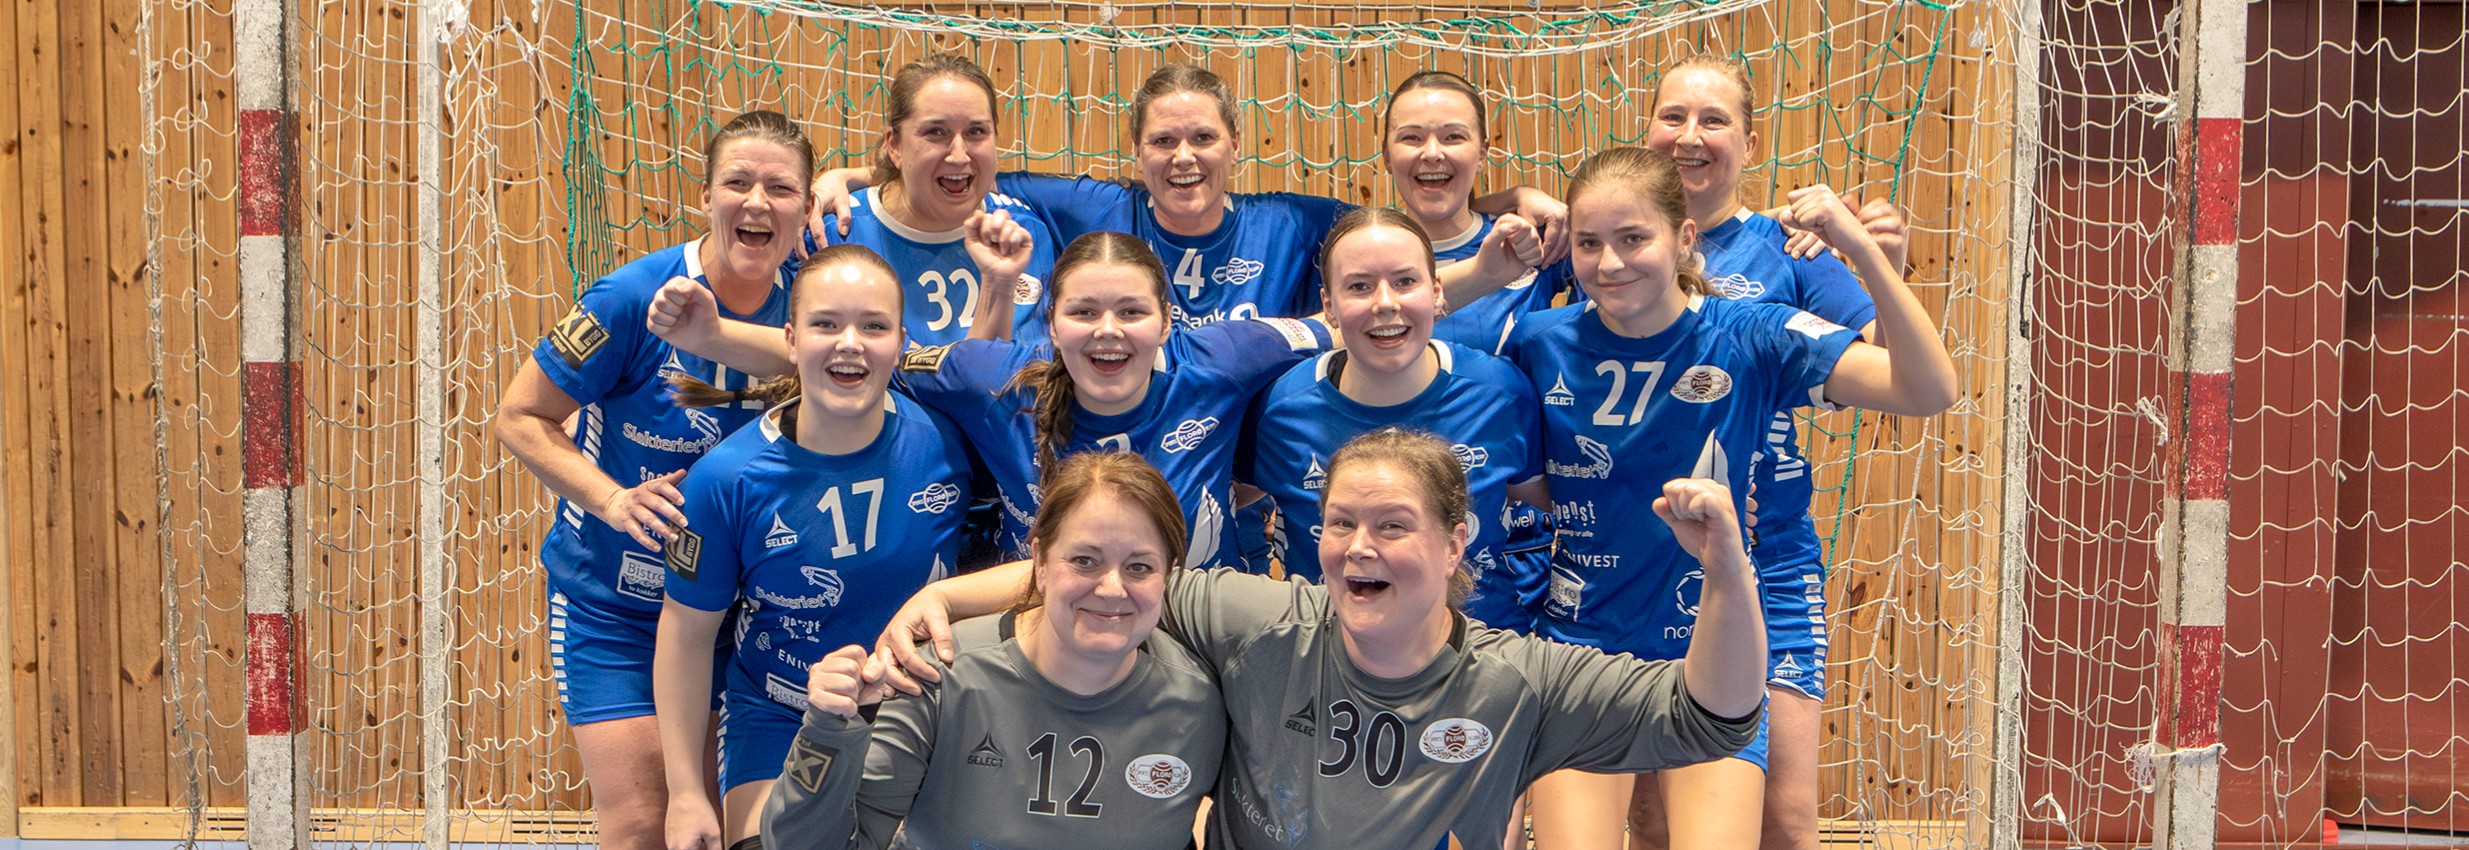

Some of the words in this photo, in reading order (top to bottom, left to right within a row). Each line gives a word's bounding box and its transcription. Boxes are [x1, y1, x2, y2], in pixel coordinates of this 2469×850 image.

[1173, 248, 1205, 300] 4
[917, 268, 979, 331] 32
[1544, 395, 1576, 407] SELECT
[1592, 359, 1667, 427] 27
[622, 422, 701, 454] Slakteriet
[1303, 479, 1328, 490] SELEC
[816, 477, 884, 560] 17
[765, 533, 798, 549] SELECT
[627, 561, 665, 581] Bistro
[1664, 625, 1696, 640] nor
[777, 648, 812, 672] ENIV
[1285, 719, 1316, 738] SELEC
[1317, 698, 1408, 789] 30
[1026, 731, 1106, 819] 12
